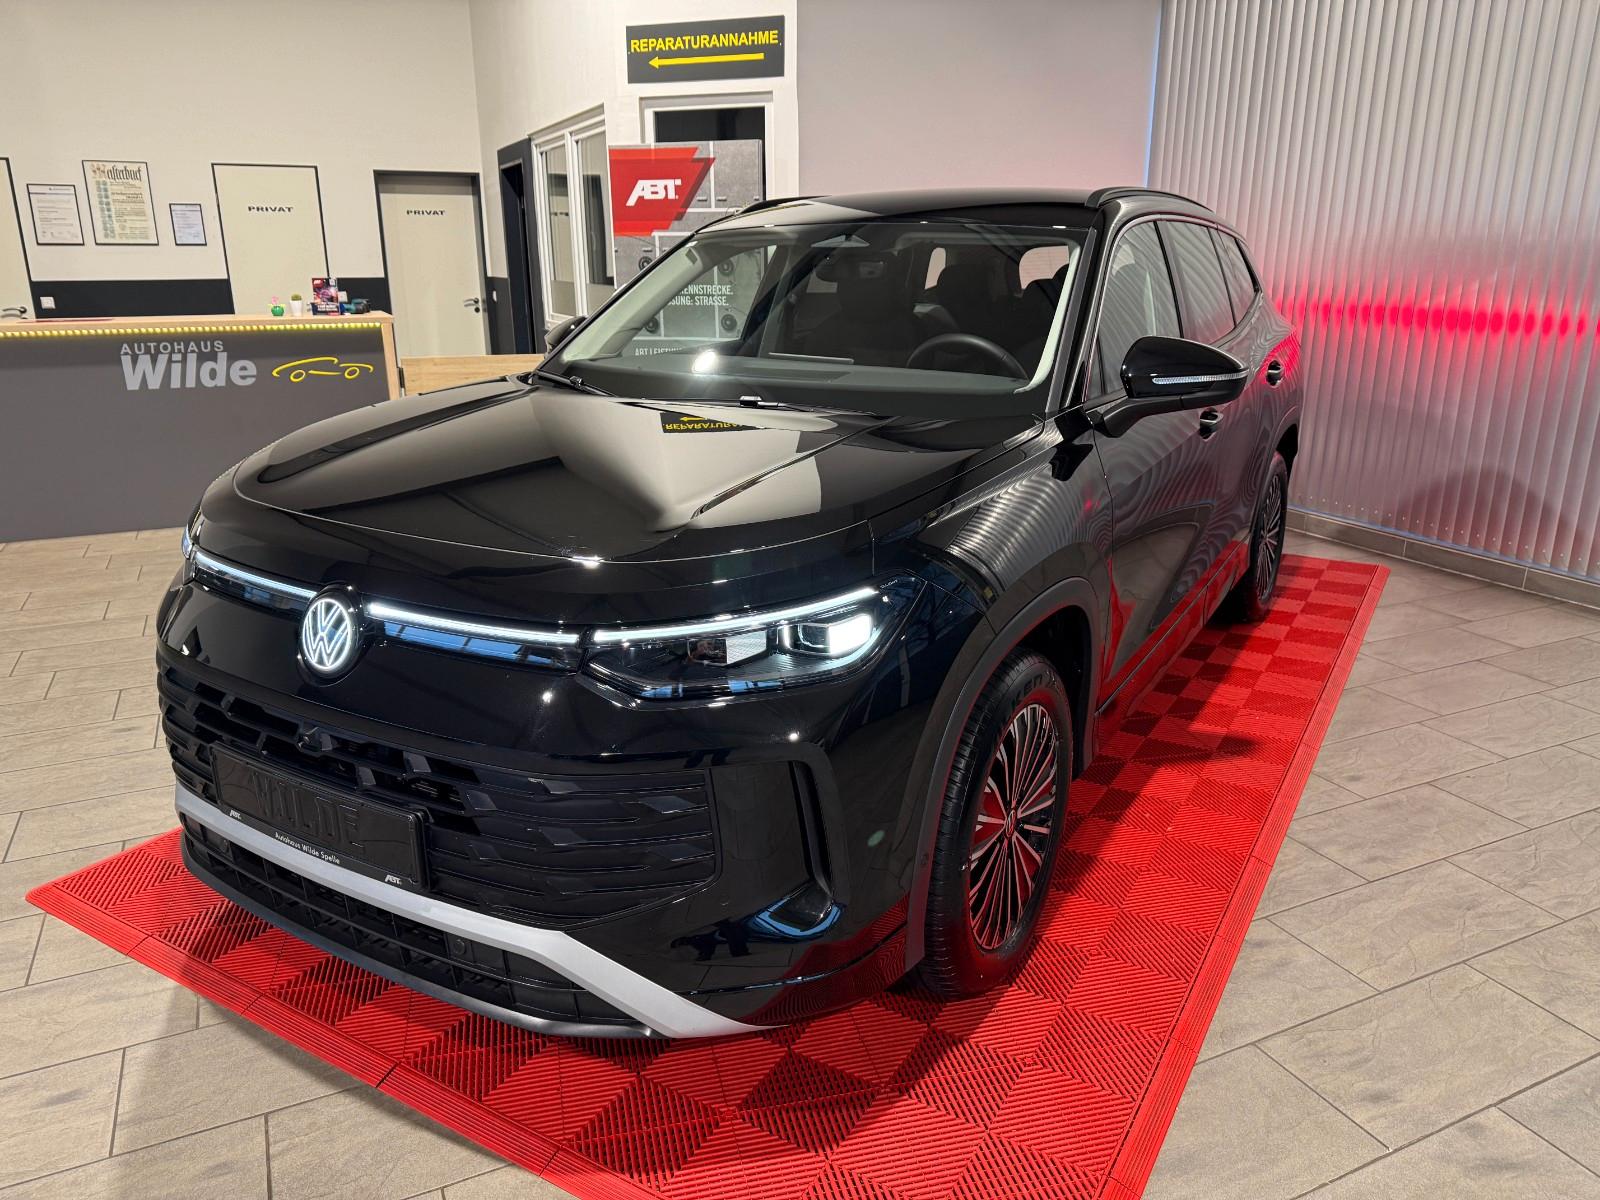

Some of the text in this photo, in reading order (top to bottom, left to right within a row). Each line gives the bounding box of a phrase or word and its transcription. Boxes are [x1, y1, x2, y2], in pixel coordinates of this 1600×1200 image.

[630, 29, 779, 53] REPARATURANNAHME
[626, 178, 682, 207] ABT
[247, 205, 294, 213] PRIVAT
[679, 284, 734, 295] ENNSTRECKE.
[695, 296, 730, 306] STRASSE.
[120, 340, 225, 355] AUTOHAUS
[120, 352, 257, 391] Wilde
[302, 843, 320, 857] Wilde
[320, 851, 341, 865] Spelle
